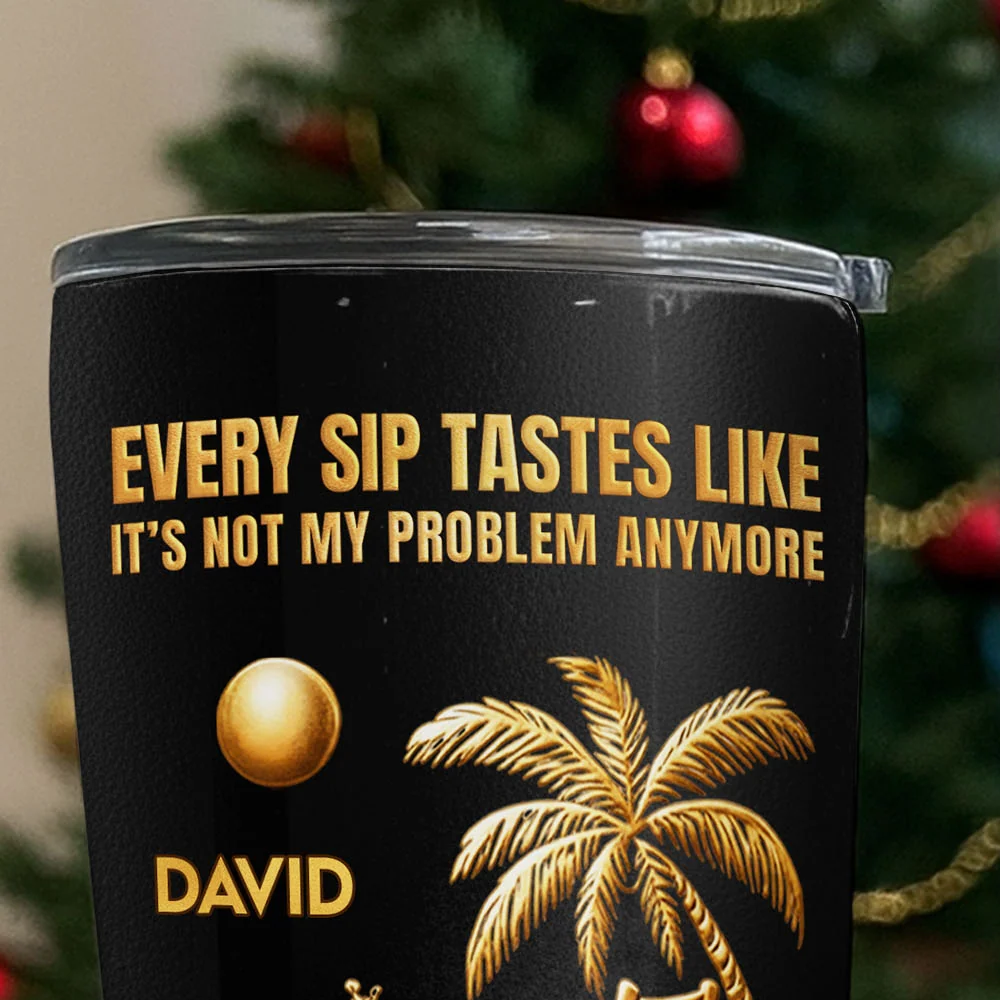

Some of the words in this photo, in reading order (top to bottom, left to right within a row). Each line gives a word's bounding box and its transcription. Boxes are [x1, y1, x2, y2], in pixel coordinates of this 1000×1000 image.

[112, 416, 298, 502] EVERY
[321, 413, 420, 492] SIP
[443, 413, 672, 498] TASTES
[695, 425, 820, 511] LIKE
[203, 514, 283, 568] NOT
[301, 511, 369, 564] MY
[389, 511, 596, 565] PROBLEM
[616, 516, 824, 580] ANYMORE
[154, 855, 354, 917] DAVID
